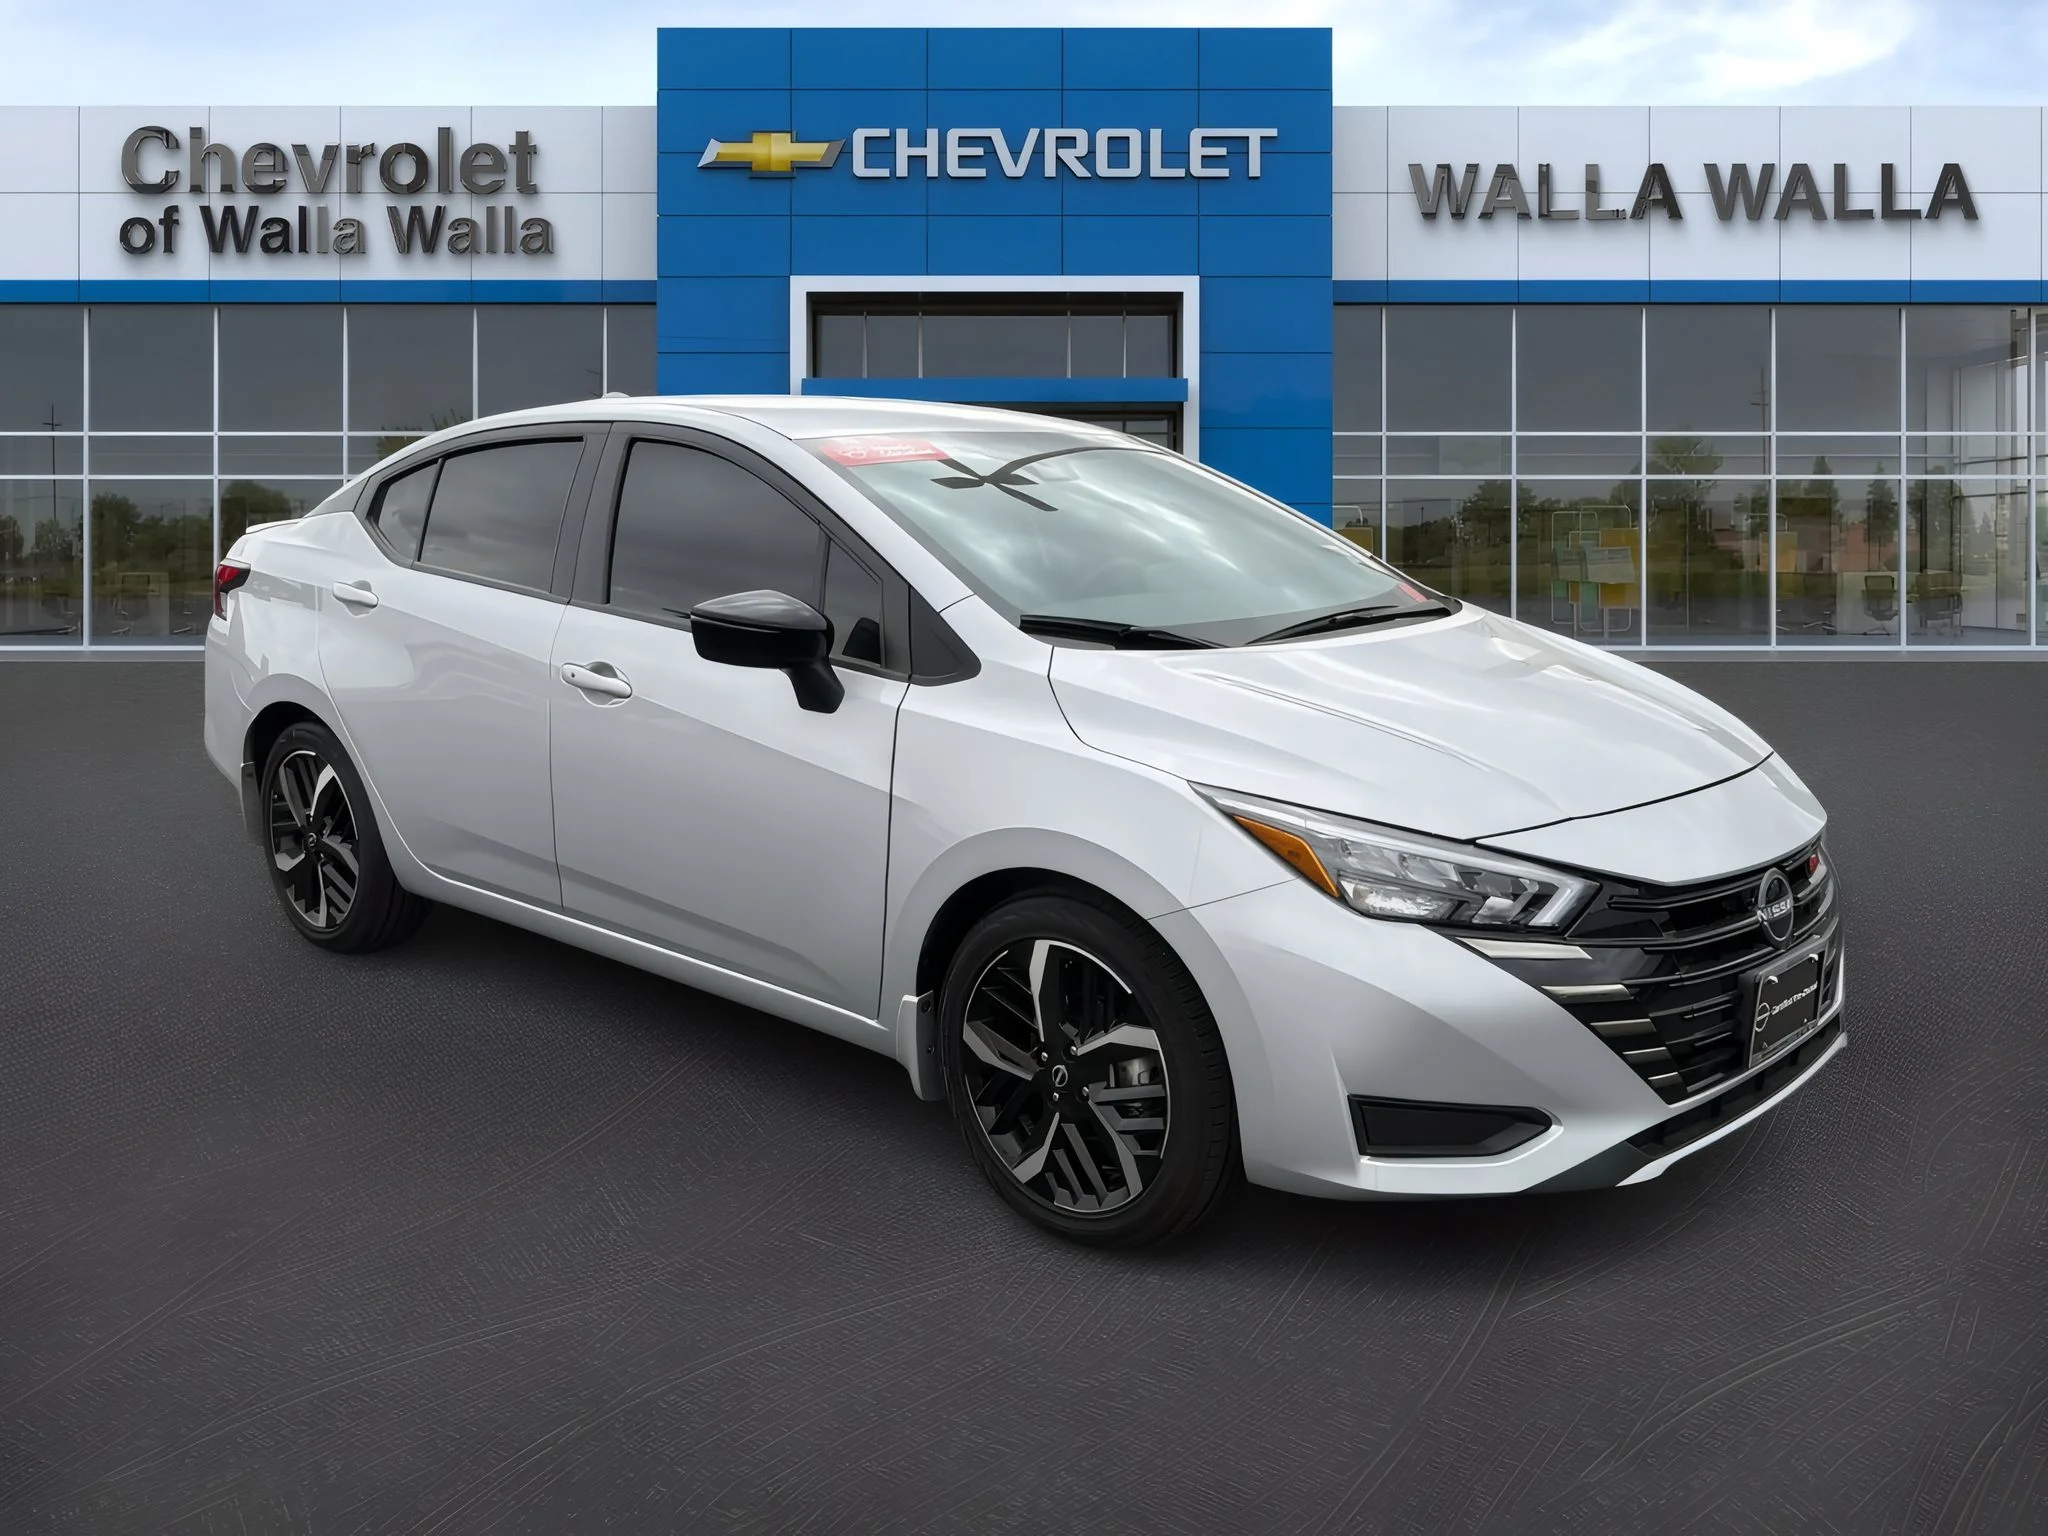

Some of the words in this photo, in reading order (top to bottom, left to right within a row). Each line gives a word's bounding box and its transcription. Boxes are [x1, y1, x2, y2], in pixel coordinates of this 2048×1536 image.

[121, 125, 538, 194] Chevrolet
[852, 128, 1278, 178] CHEVROLET
[1408, 163, 1683, 220] WALLA
[1703, 163, 1979, 220] WALLA
[119, 205, 179, 255] of
[200, 205, 366, 255] Walla
[387, 205, 554, 255] Walla
